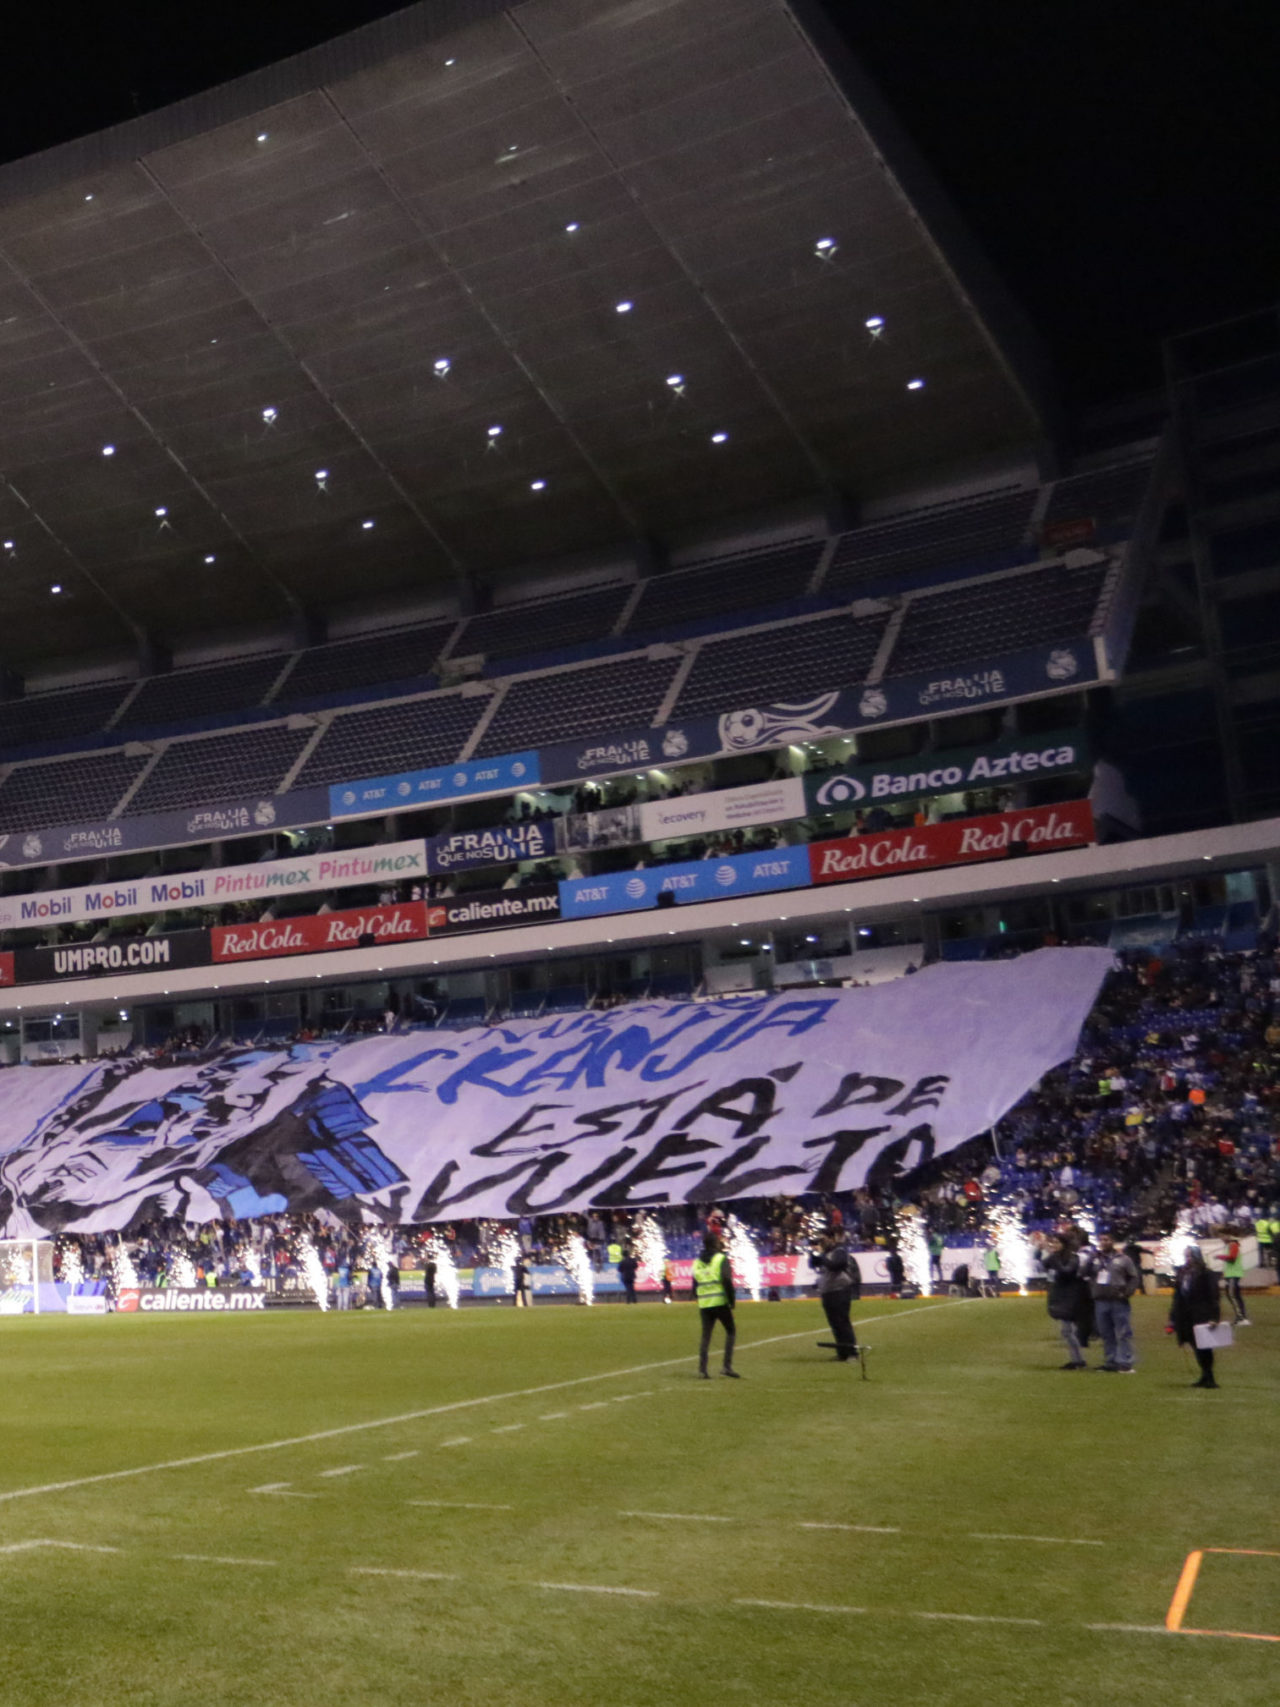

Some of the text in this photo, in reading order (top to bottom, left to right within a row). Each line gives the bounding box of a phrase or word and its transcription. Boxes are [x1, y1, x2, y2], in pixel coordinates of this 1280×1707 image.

[363, 768, 500, 800] AT&T AT&T AT&T
[871, 745, 1075, 798] Banco Azteca
[437, 839, 545, 867] QUE NOS UNE
[449, 824, 543, 852] FRANJA
[214, 853, 421, 894] Pintumex Pintumex
[575, 860, 791, 902] AT&T AT&T AT&T
[21, 879, 206, 919] Mobil Mobil Mobil
[448, 895, 559, 923] caliente.mx
[811, 1072, 950, 1118] DE
[140, 1289, 266, 1310] caliente.mx
